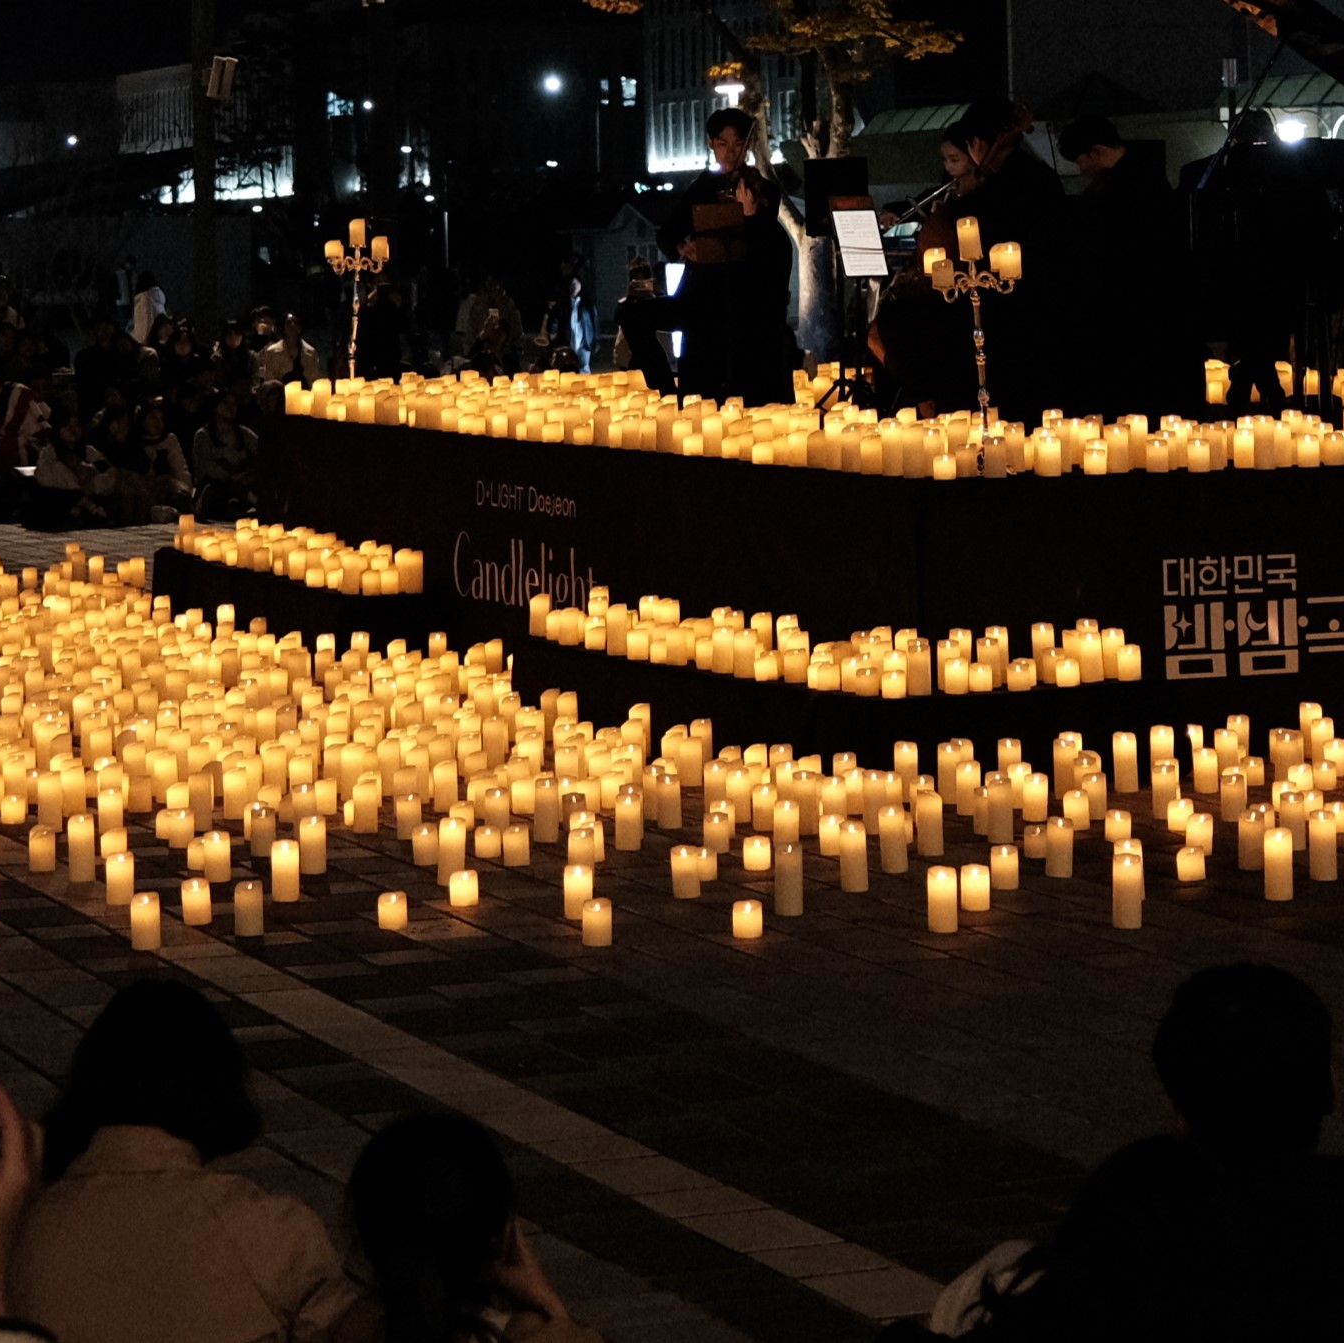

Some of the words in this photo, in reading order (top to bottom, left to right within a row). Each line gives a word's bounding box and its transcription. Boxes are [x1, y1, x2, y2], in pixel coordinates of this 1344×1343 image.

[527, 485, 577, 518] Daejeon
[453, 530, 598, 613] Candlelight
[1161, 552, 1298, 597] 대한민국
